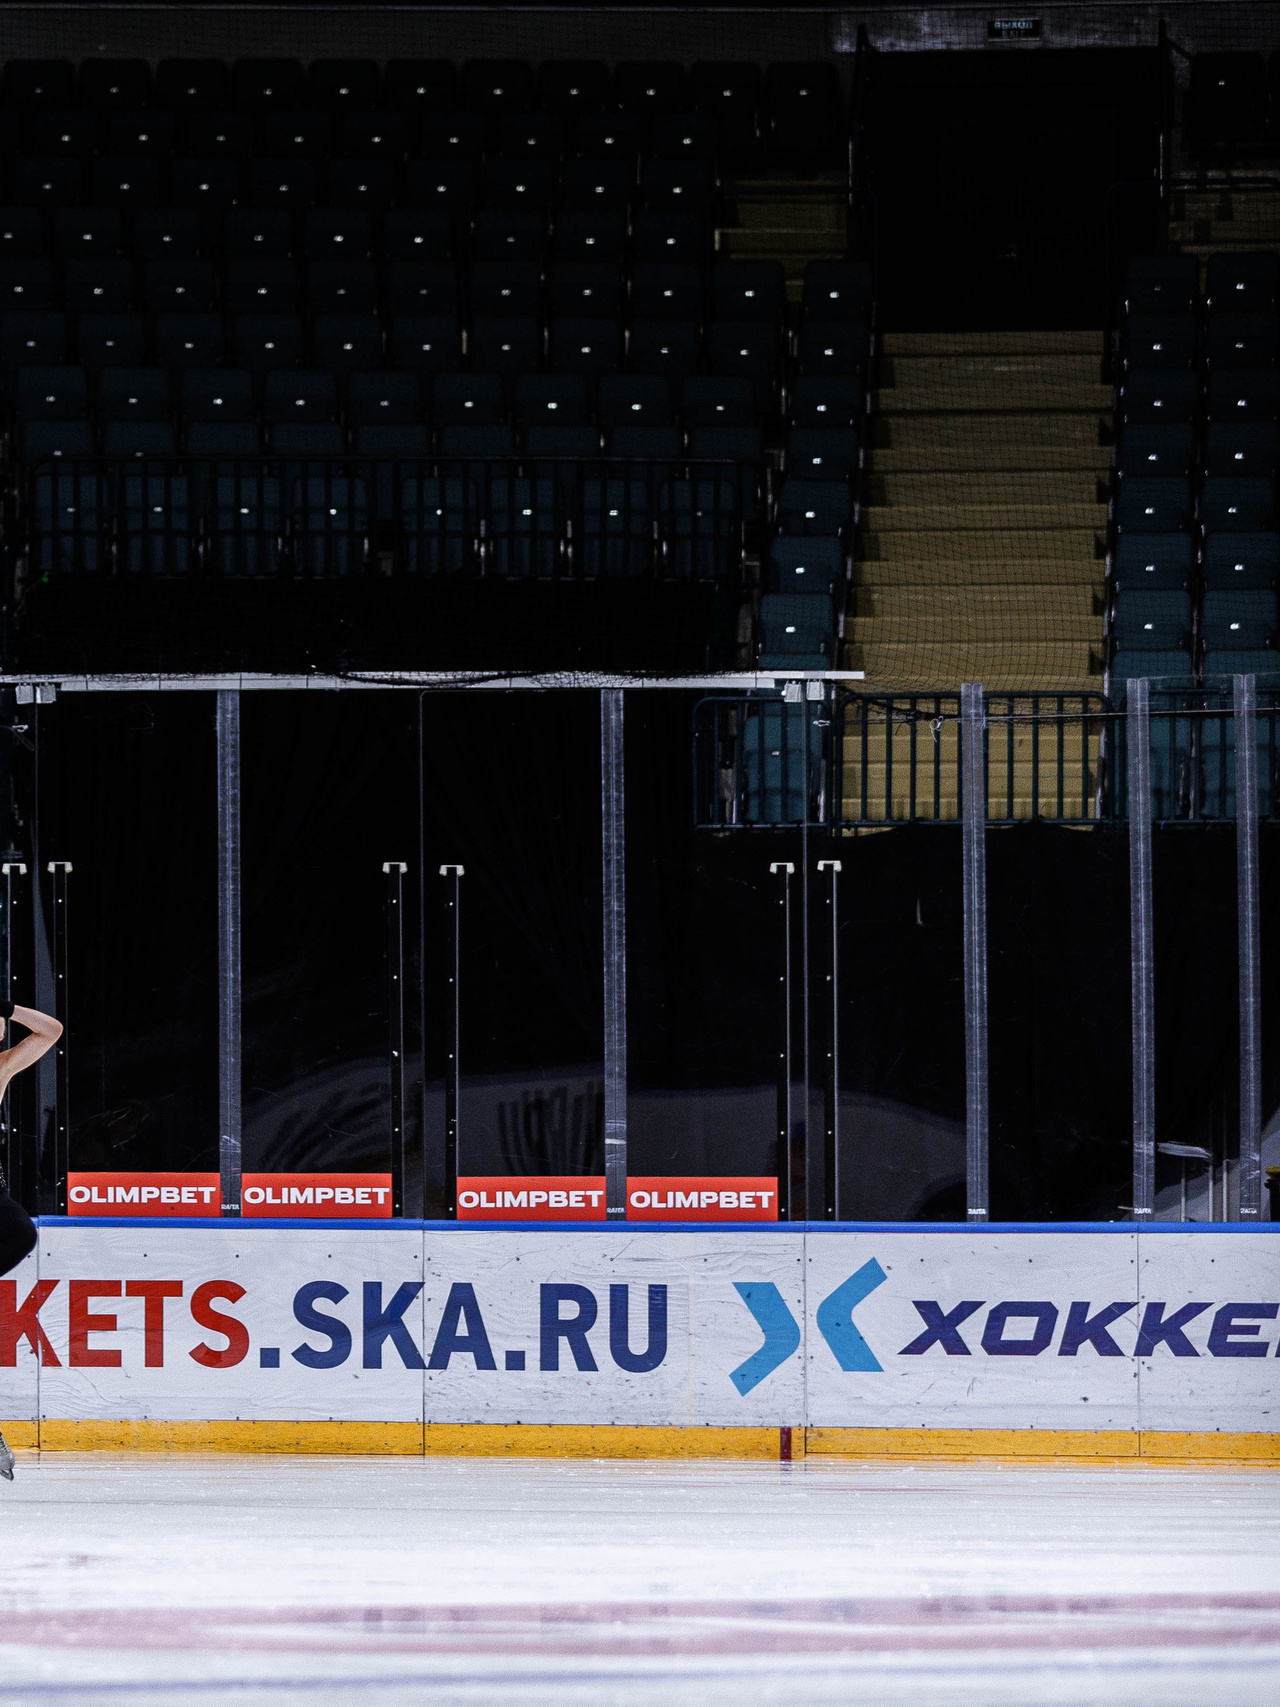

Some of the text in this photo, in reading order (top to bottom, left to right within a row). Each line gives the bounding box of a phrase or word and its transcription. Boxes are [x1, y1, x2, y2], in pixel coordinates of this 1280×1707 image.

[70, 1186, 217, 1204] OLIMPBET
[245, 1186, 391, 1205] OLIMPBET
[458, 1190, 604, 1208] OLIMPBET
[629, 1190, 775, 1209] OLIMPBET
[898, 1300, 1280, 1358] ХОККЕ
